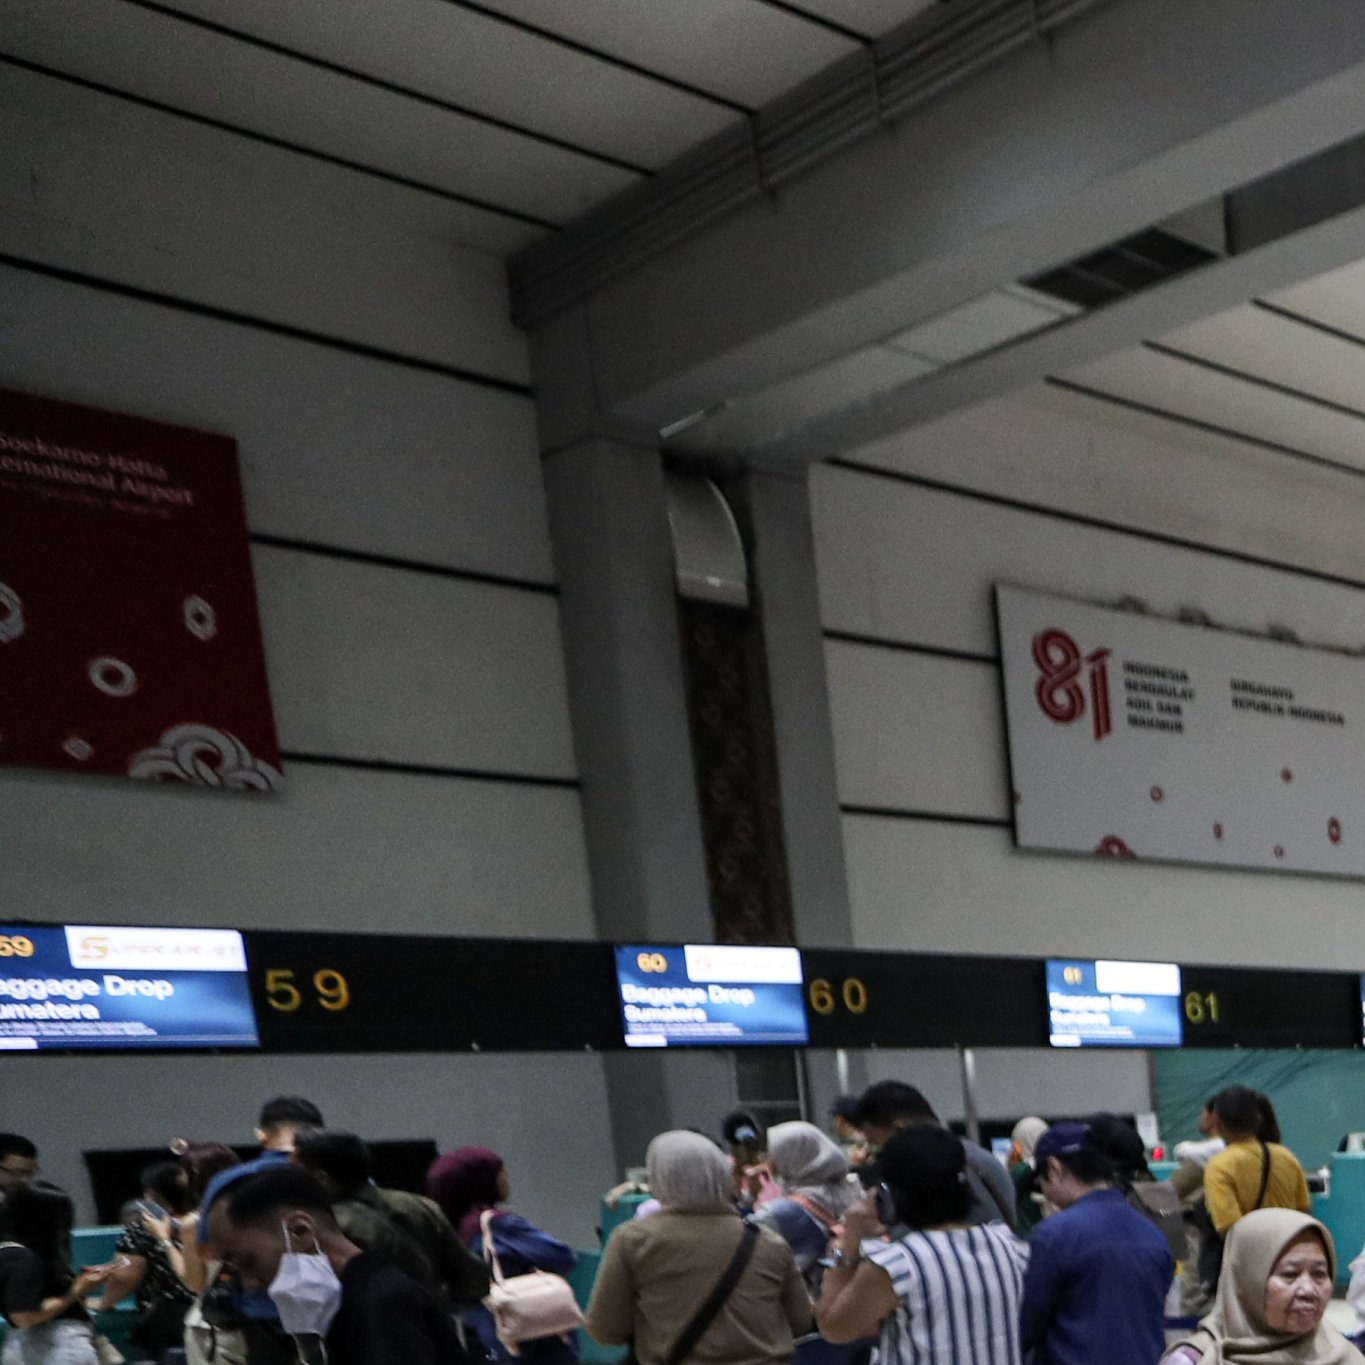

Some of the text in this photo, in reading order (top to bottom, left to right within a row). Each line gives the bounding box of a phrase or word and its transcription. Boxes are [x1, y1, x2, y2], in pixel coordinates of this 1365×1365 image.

[1032, 628, 1112, 741] 81
[1123, 661, 1189, 683] INDONESIA
[103, 975, 175, 1000] Drop
[266, 969, 349, 1011] 59
[809, 978, 868, 1014] 60
[1185, 991, 1219, 1024] 61
